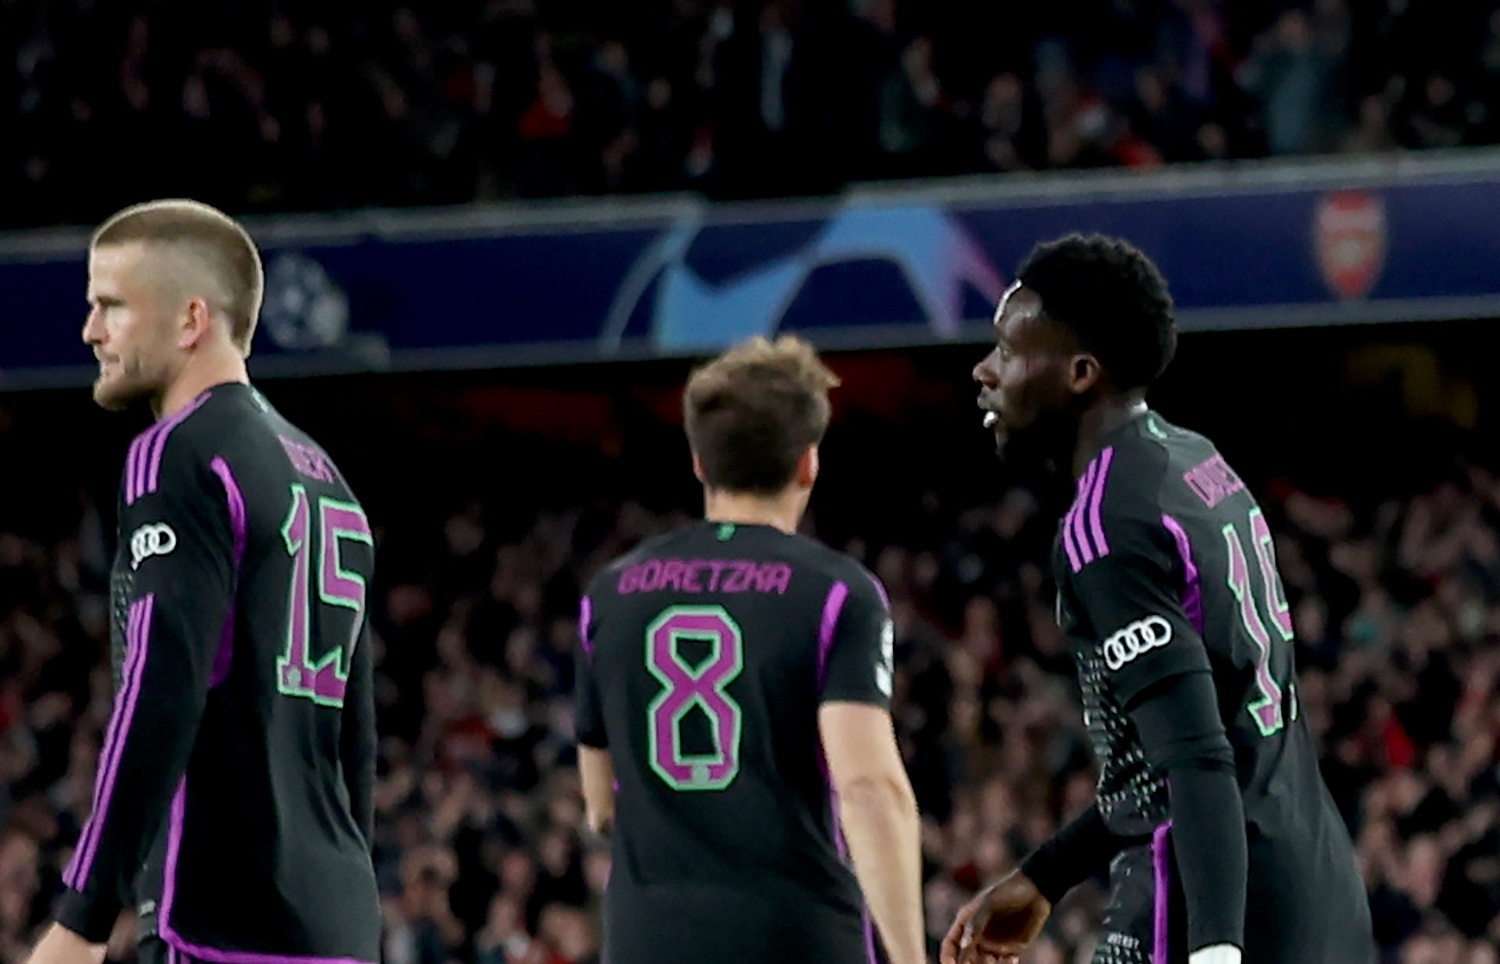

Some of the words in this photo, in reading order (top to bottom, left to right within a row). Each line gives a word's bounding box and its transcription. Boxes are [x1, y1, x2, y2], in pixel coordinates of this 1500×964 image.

[277, 483, 374, 708] 15
[617, 559, 793, 595] GORETZKA
[644, 603, 744, 792] 8
